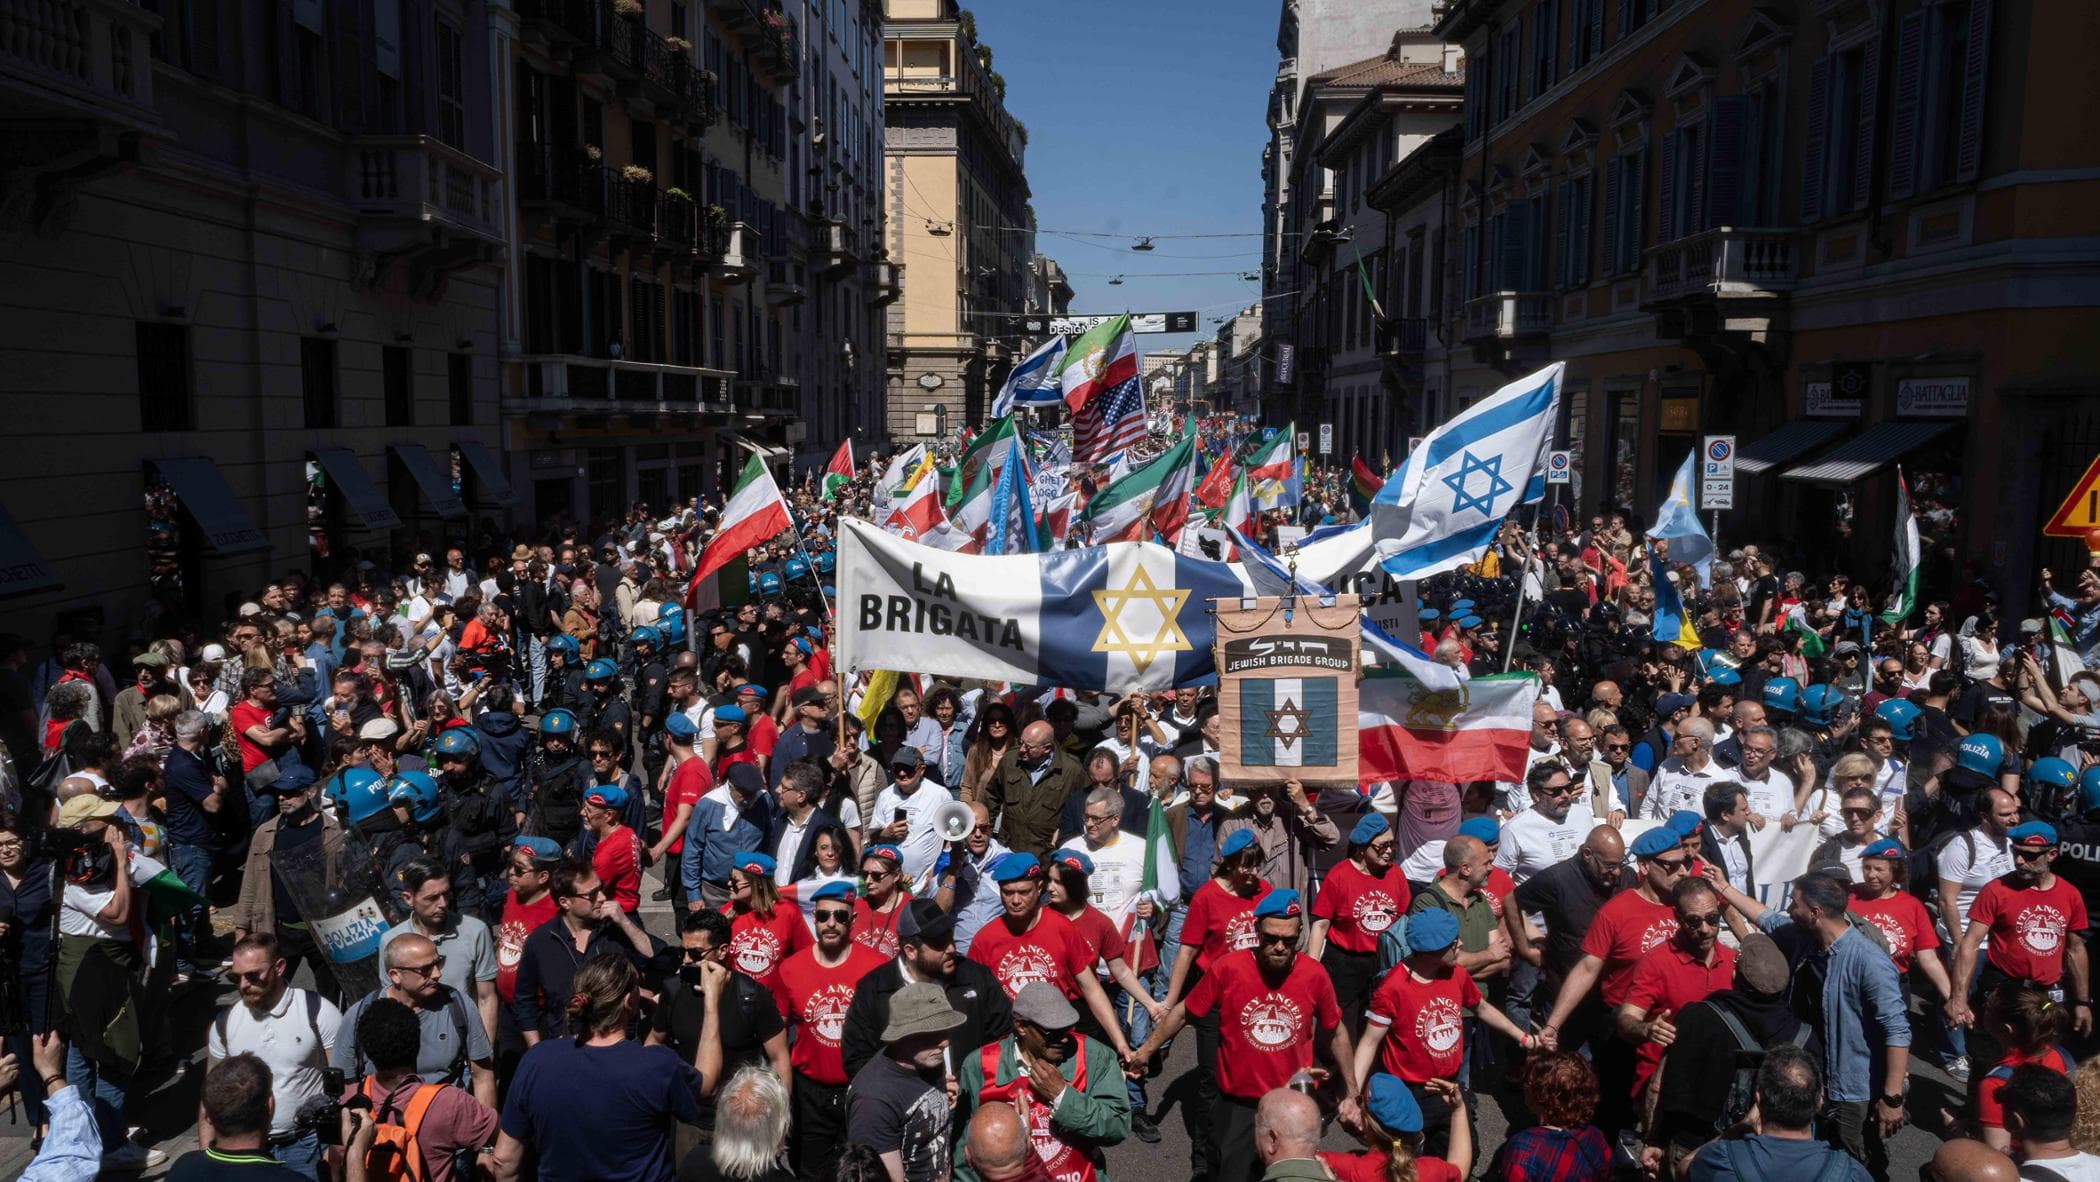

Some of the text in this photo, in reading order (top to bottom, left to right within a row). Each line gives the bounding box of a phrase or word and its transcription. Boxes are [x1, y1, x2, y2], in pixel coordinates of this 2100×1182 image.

[1915, 385, 1967, 401] BATTAGLIA
[913, 561, 957, 602] LA
[859, 594, 1024, 651] BRIGATA
[1228, 655, 1348, 671] JEWISH BRIGADE GROUP
[1960, 744, 1991, 759] POLIZIA
[1352, 894, 1366, 918] CITY
[2015, 907, 2031, 934] CITY
[324, 917, 381, 952] POLIZIA
[729, 928, 748, 954] CITY
[1641, 924, 1656, 954] CITY
[998, 944, 1057, 981] CITY ANGELS
[803, 989, 822, 1023] CITY
[1240, 992, 1303, 1030] CITY ANGELS
[1415, 1005, 1429, 1038] CITY
